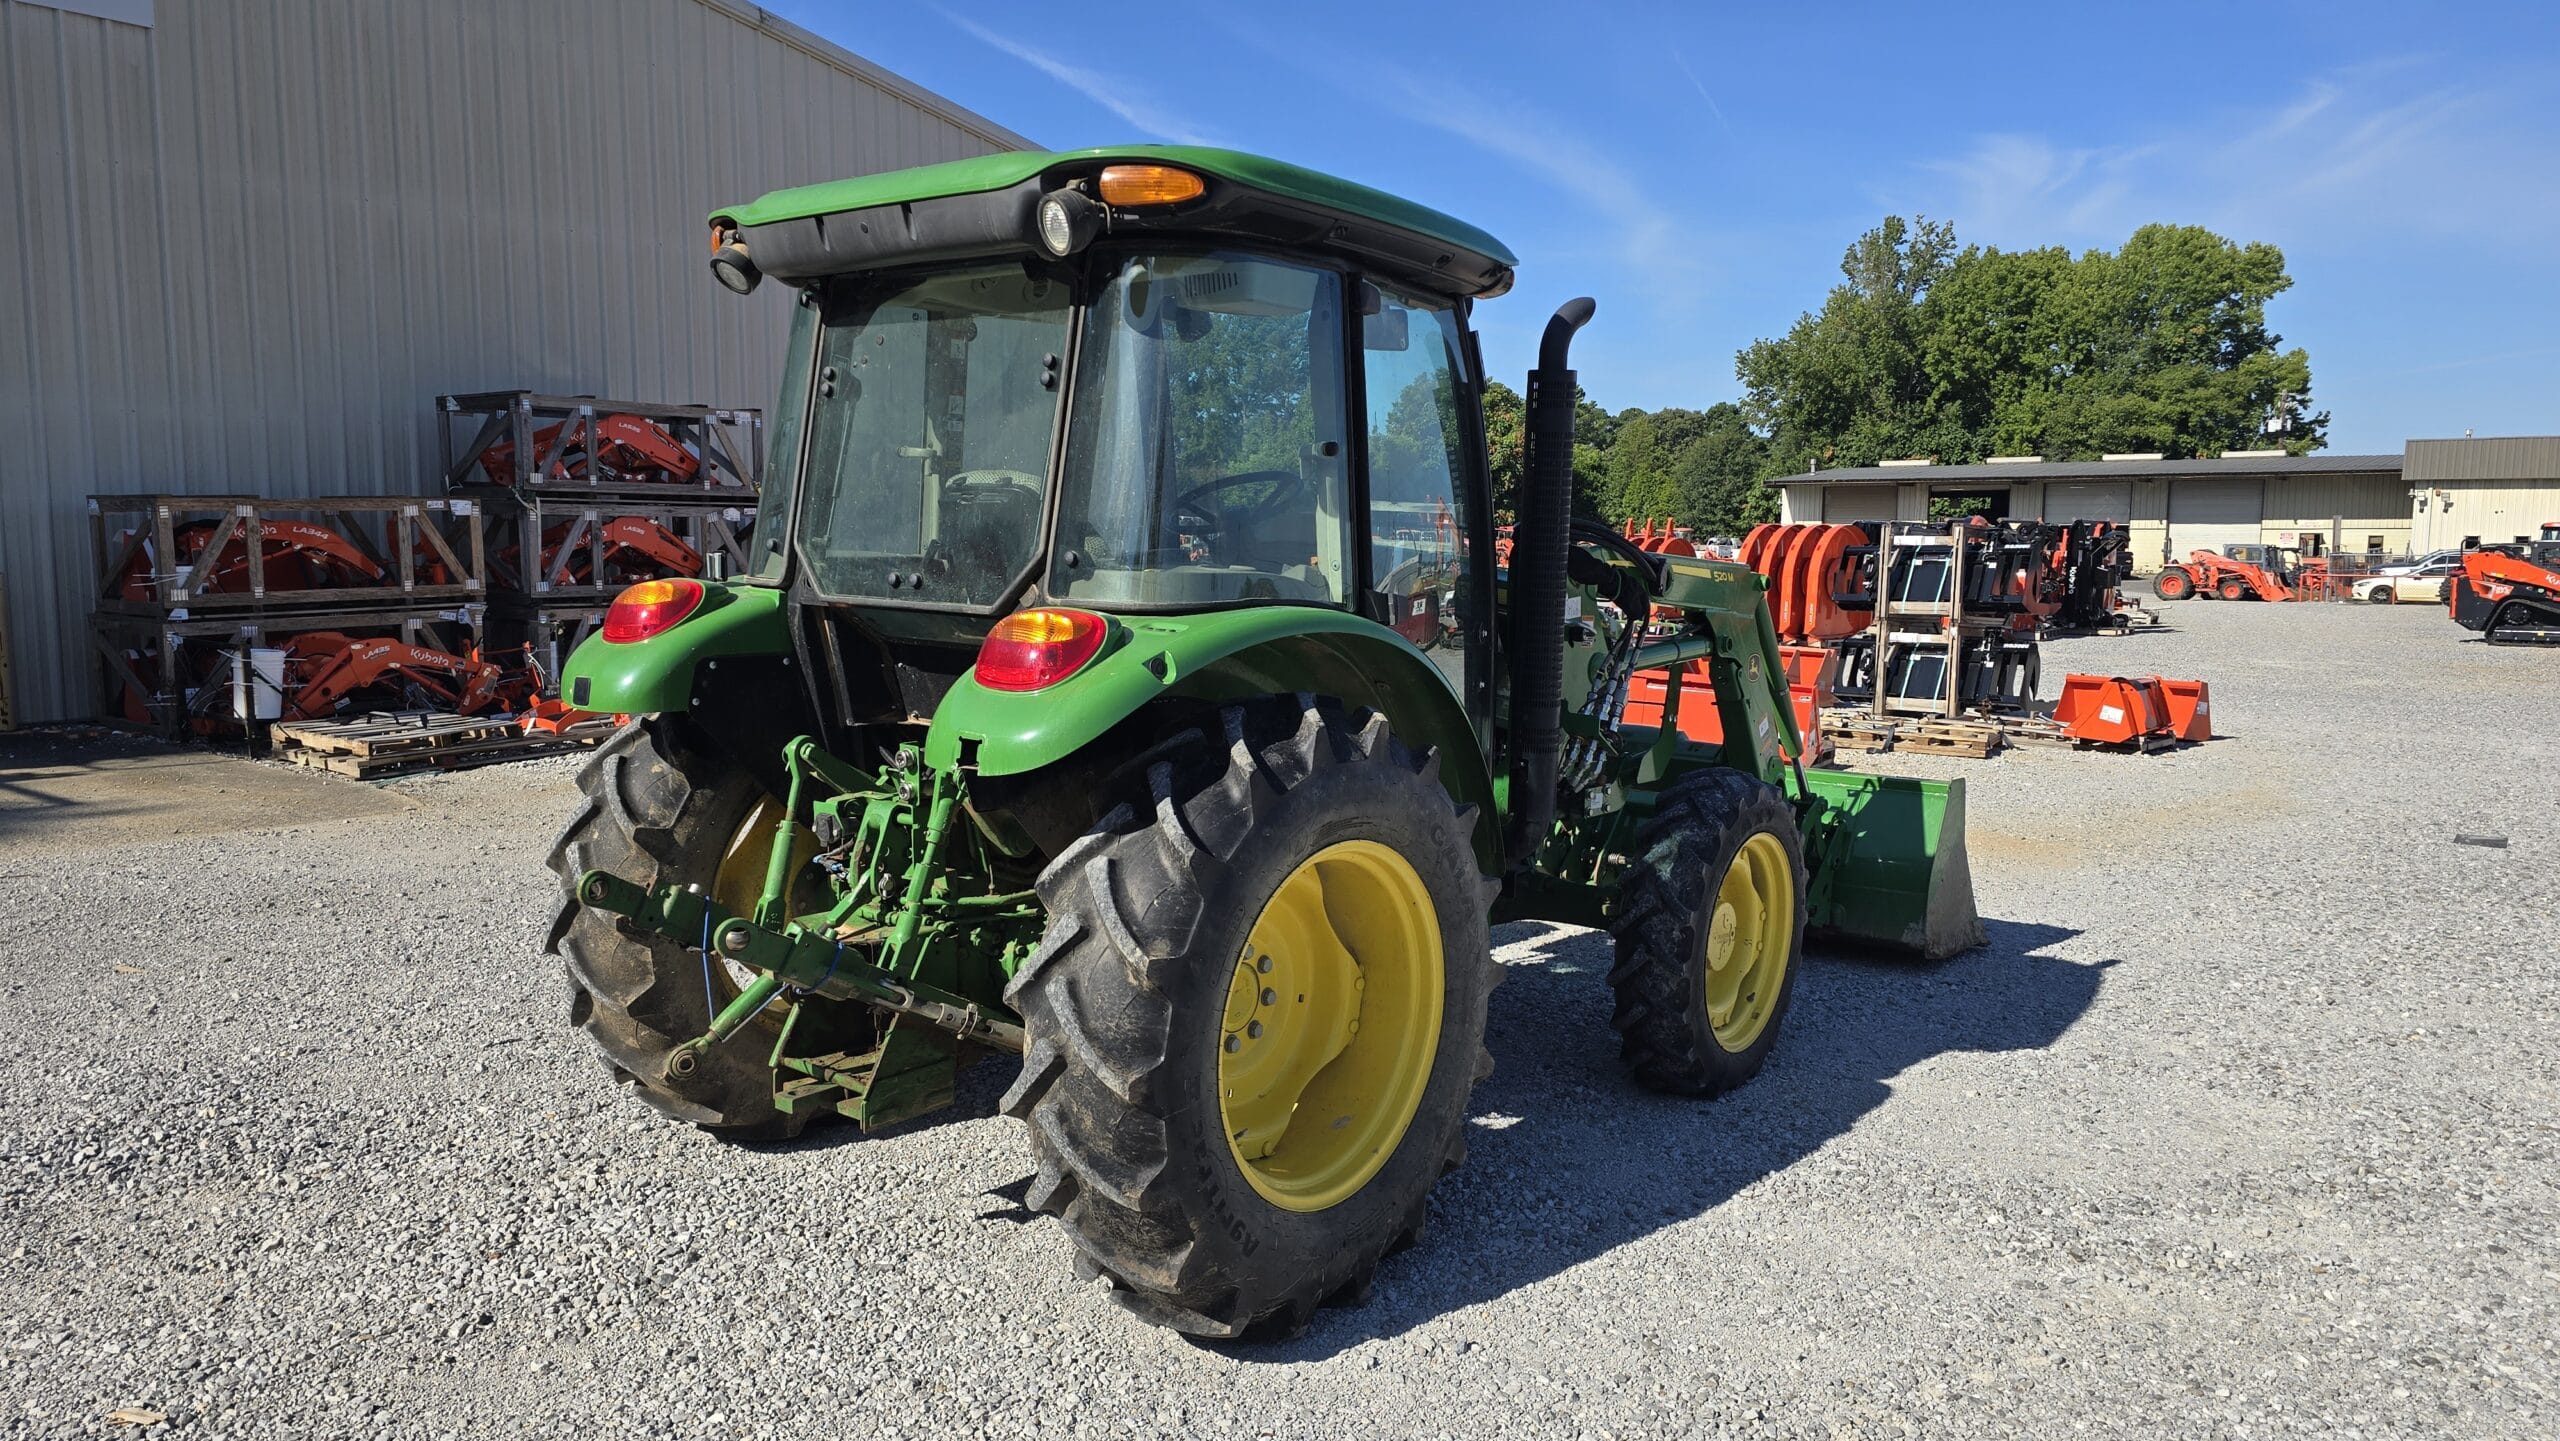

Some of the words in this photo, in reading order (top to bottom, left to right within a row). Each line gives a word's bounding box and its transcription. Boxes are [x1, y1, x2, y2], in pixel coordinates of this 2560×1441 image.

[292, 526, 329, 540] LA344
[362, 645, 391, 660] LA435
[410, 648, 449, 666] Kubota
